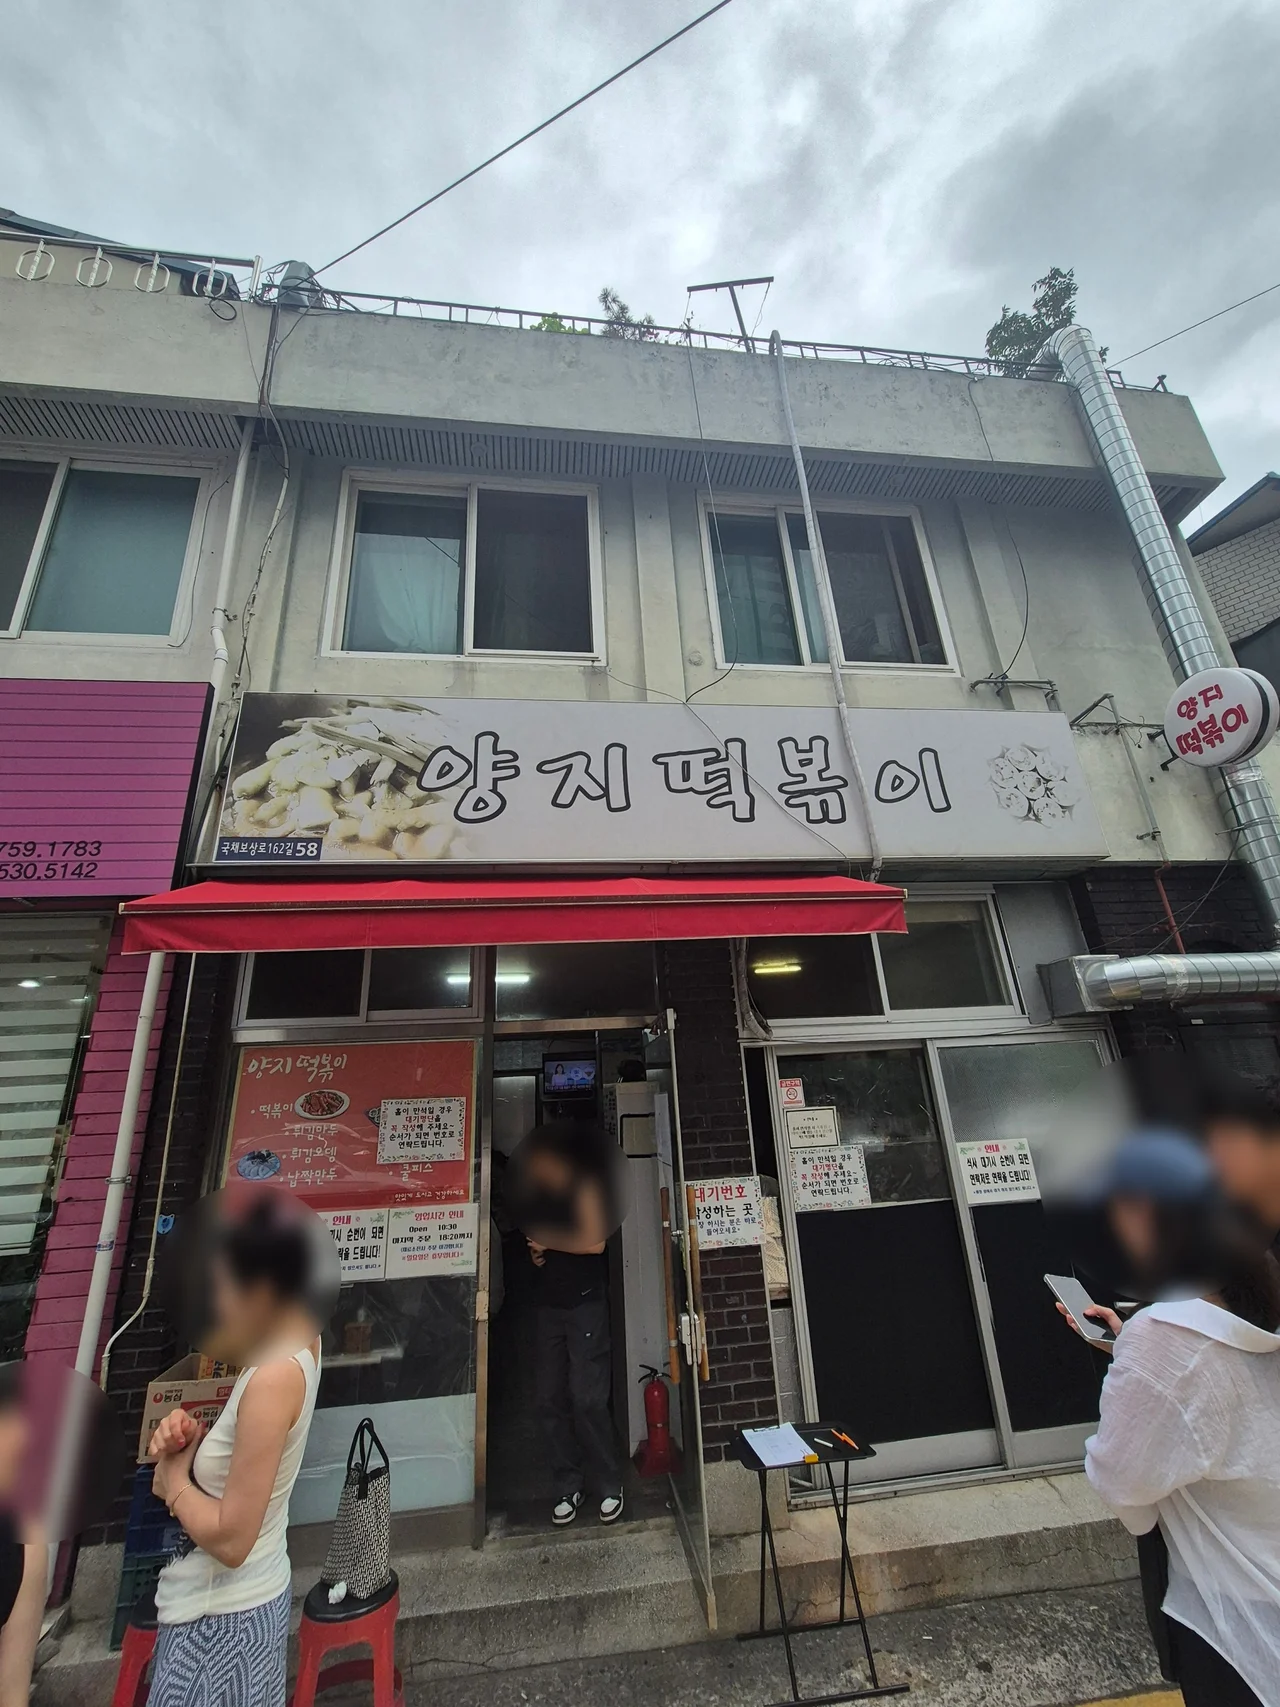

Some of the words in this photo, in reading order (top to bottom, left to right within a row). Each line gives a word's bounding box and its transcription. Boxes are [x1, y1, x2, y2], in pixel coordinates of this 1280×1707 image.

[1177, 684, 1223, 720] 양지
[1176, 703, 1249, 755] 떡볶이
[0, 841, 102, 857] 759.1783
[221, 841, 294, 856] 국채보상로162길
[295, 842, 318, 857] 58
[0, 862, 98, 880] 530.5142
[247, 1056, 292, 1079] 양지
[296, 1053, 348, 1083] 떡볶이
[259, 1102, 293, 1119] 떡볶이
[395, 1107, 409, 1116] 홀이
[413, 1106, 435, 1115] 만석일
[438, 1105, 453, 1114] 경우
[405, 1114, 441, 1123] 대기명단을
[292, 1123, 338, 1141] 튀김만두
[390, 1124, 398, 1132] 꼭
[401, 1123, 423, 1132] 작성해
[389, 1132, 412, 1141] 순서가
[415, 1131, 430, 1140] 되면
[433, 1130, 455, 1139] 번호로
[290, 1146, 337, 1164] 튀김오뎅
[984, 1144, 1000, 1153] 안내
[817, 1154, 837, 1163] 만석일
[840, 1154, 853, 1162] 경우
[1000, 1154, 1016, 1167] 순번이
[1018, 1153, 1030, 1165] 되면
[400, 1163, 433, 1182] 쿨피스
[812, 1162, 844, 1172] 대기명단을
[287, 1168, 338, 1188] 납짝만두
[801, 1181, 821, 1190] 순서가
[824, 1180, 837, 1188] 되면
[840, 1178, 859, 1186] 번호로
[694, 1184, 747, 1202] 대기번호
[414, 1211, 445, 1221] 영업시간
[448, 1210, 464, 1219] 안내
[742, 1203, 753, 1217] 곳
[332, 1214, 352, 1226] 안내
[707, 1220, 726, 1228] 하시는
[729, 1218, 742, 1226] 분은
[744, 1216, 757, 1225] 바로
[330, 1228, 342, 1243] 기시
[347, 1227, 366, 1242] 순번이
[371, 1225, 385, 1240] 되면
[408, 1225, 428, 1233] Open
[438, 1223, 457, 1231] 10:30
[417, 1235, 431, 1243] 주문
[439, 1232, 473, 1241] 18:20까지
[337, 1247, 350, 1261] 락을
[164, 1393, 182, 1403] 농심
[203, 1410, 218, 1418] 농심
